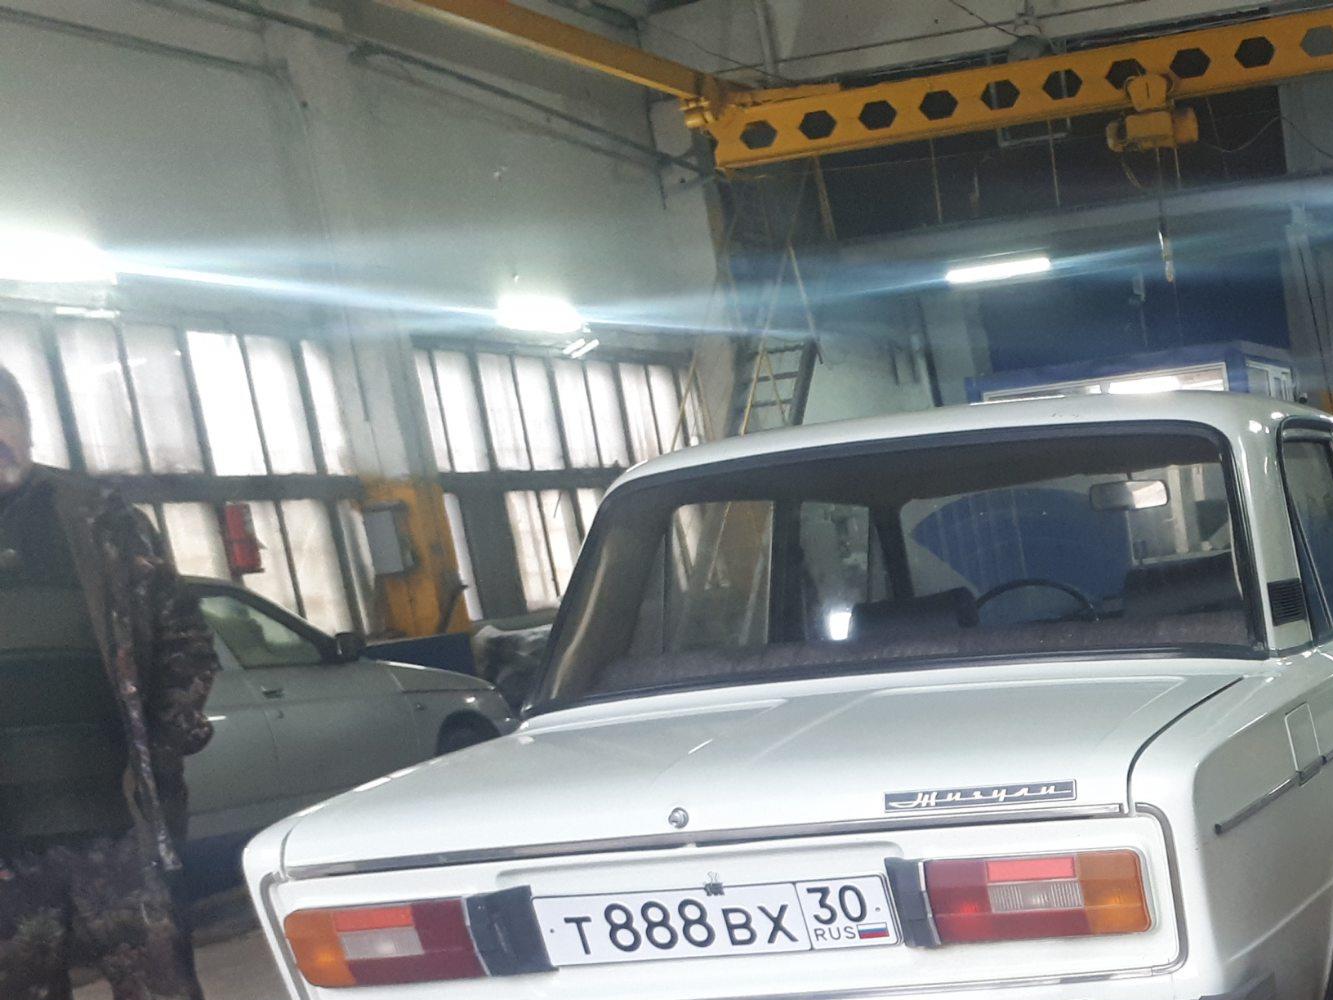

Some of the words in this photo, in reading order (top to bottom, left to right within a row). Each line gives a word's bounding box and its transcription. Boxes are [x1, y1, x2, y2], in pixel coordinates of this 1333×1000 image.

[806, 885, 867, 925] 30
[564, 898, 799, 954] Т888ВХ
[813, 925, 857, 942] RUS
